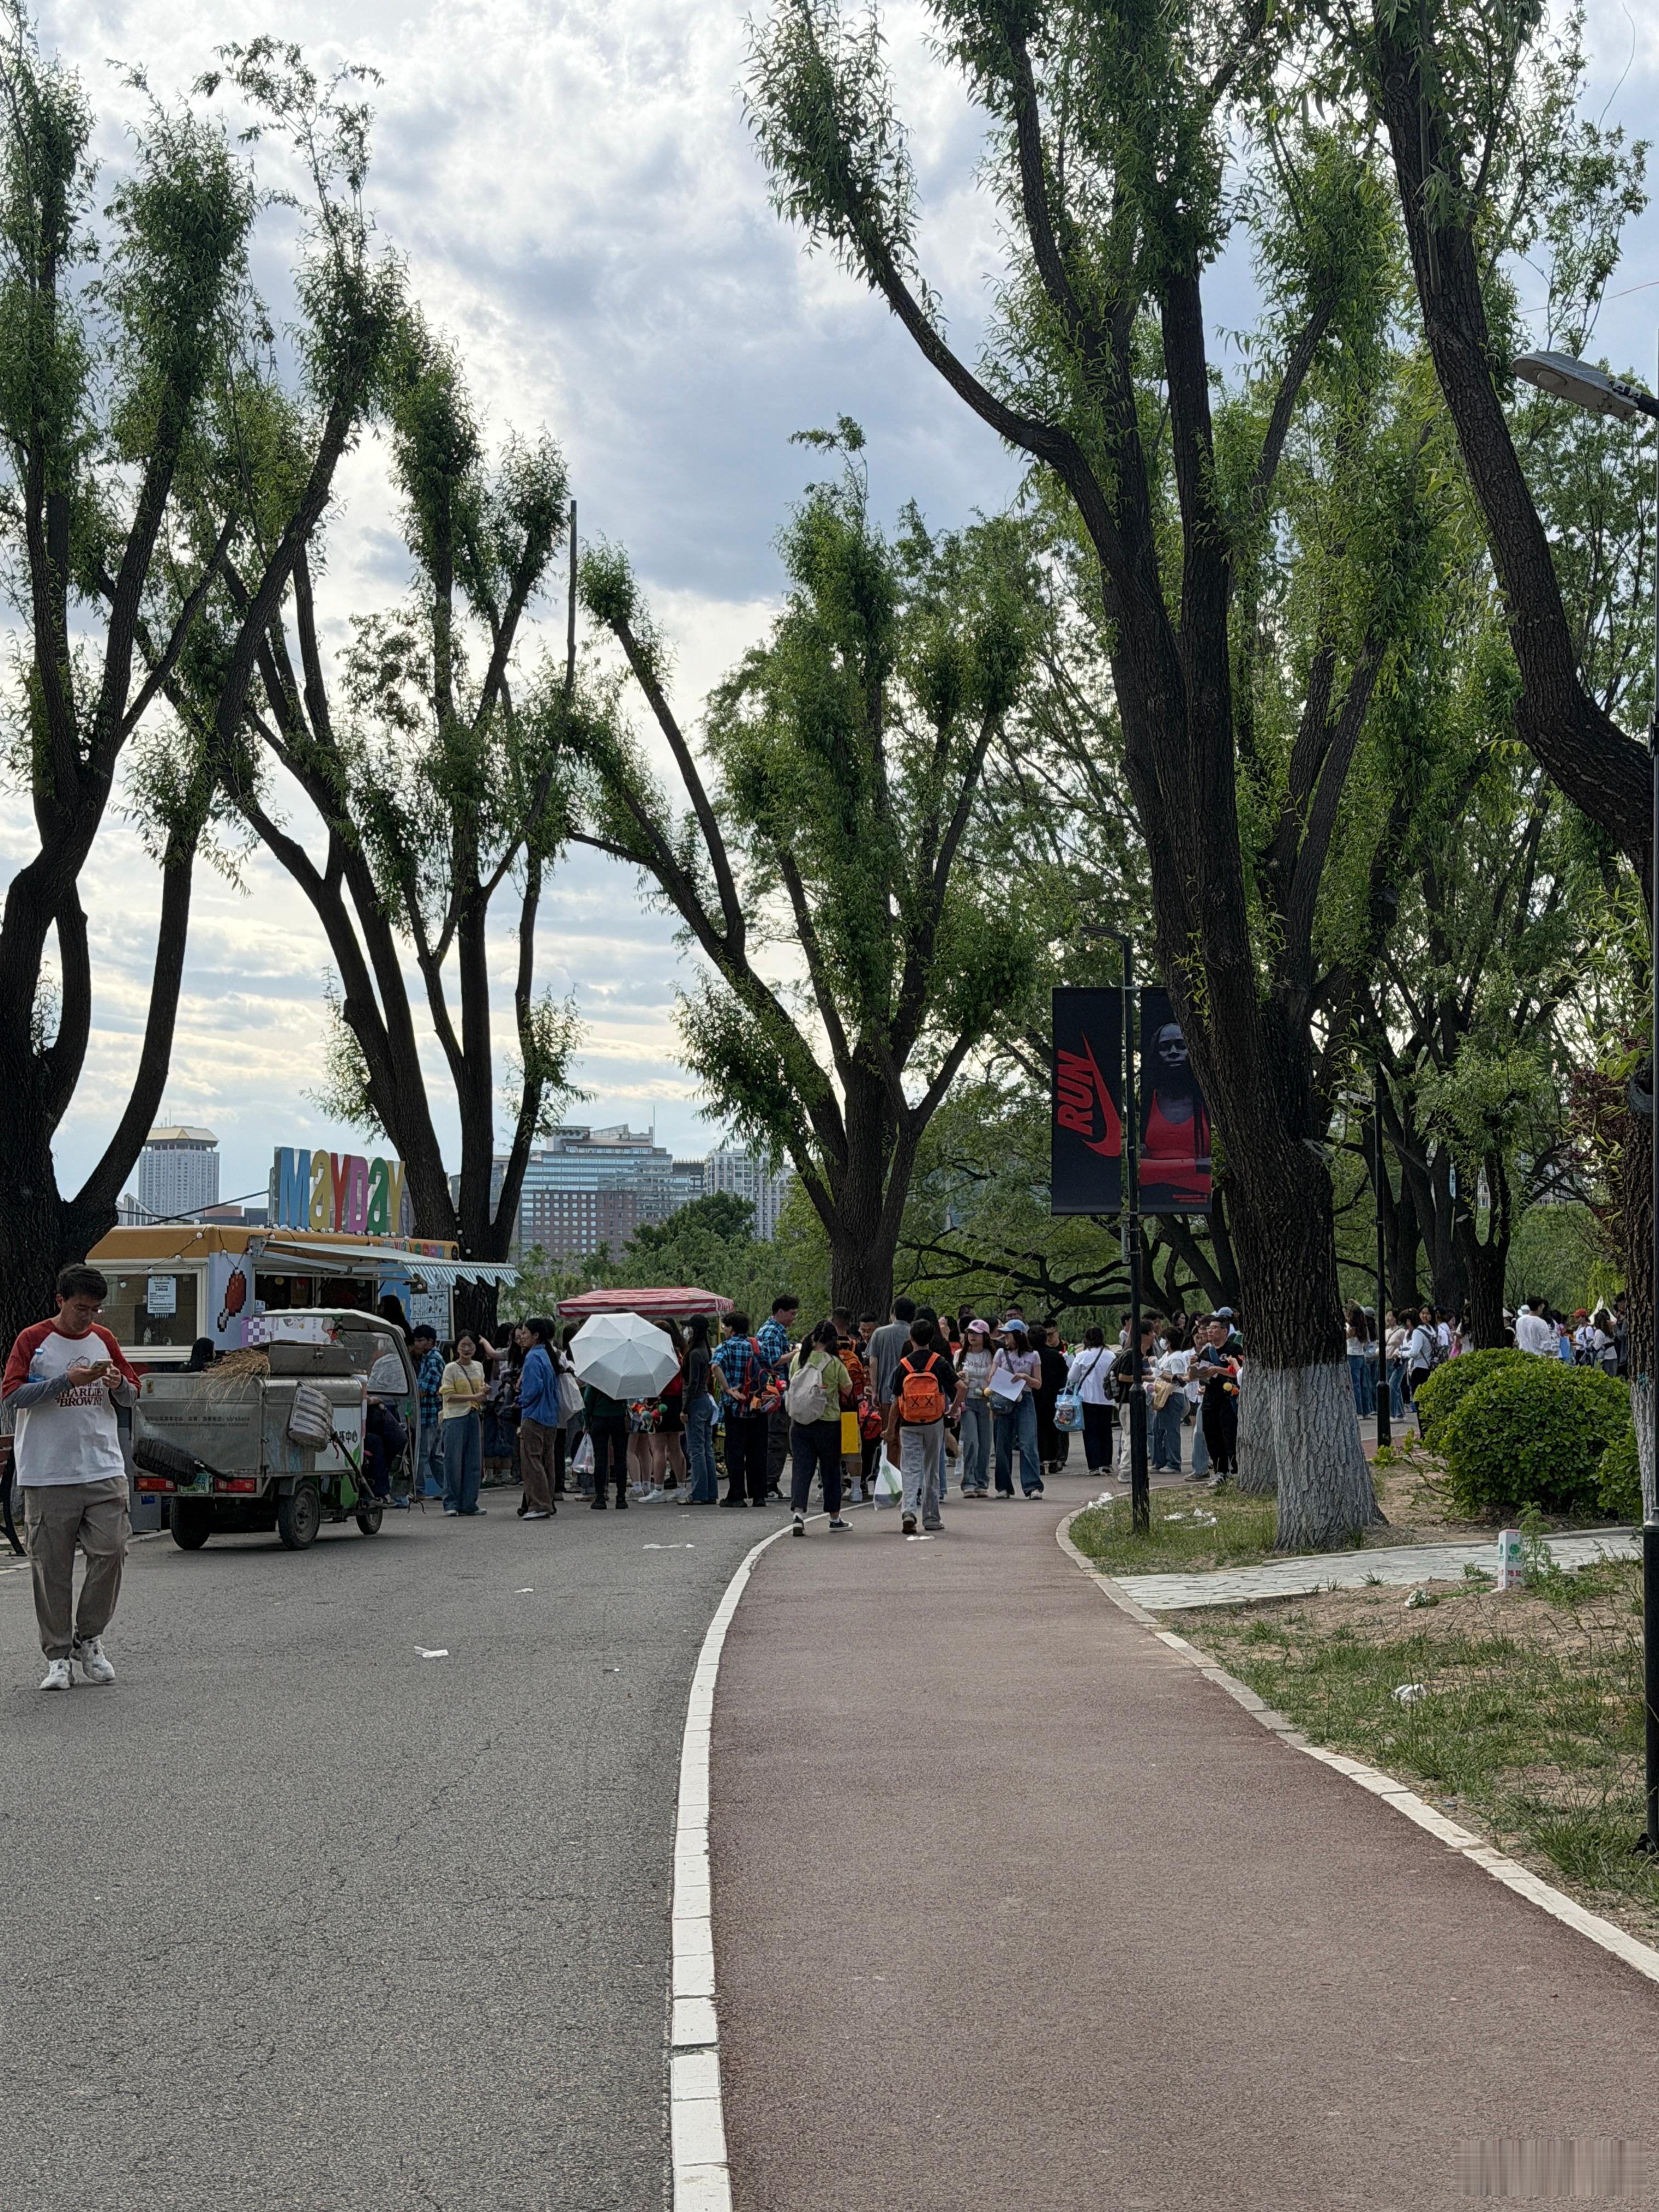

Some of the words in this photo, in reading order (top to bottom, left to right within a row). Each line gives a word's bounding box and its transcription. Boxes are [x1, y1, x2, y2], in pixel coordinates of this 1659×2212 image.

[1057, 1048, 1093, 1132] RUN
[58, 1388, 103, 1398] HARLIE
[59, 1397, 102, 1407] BROWN
